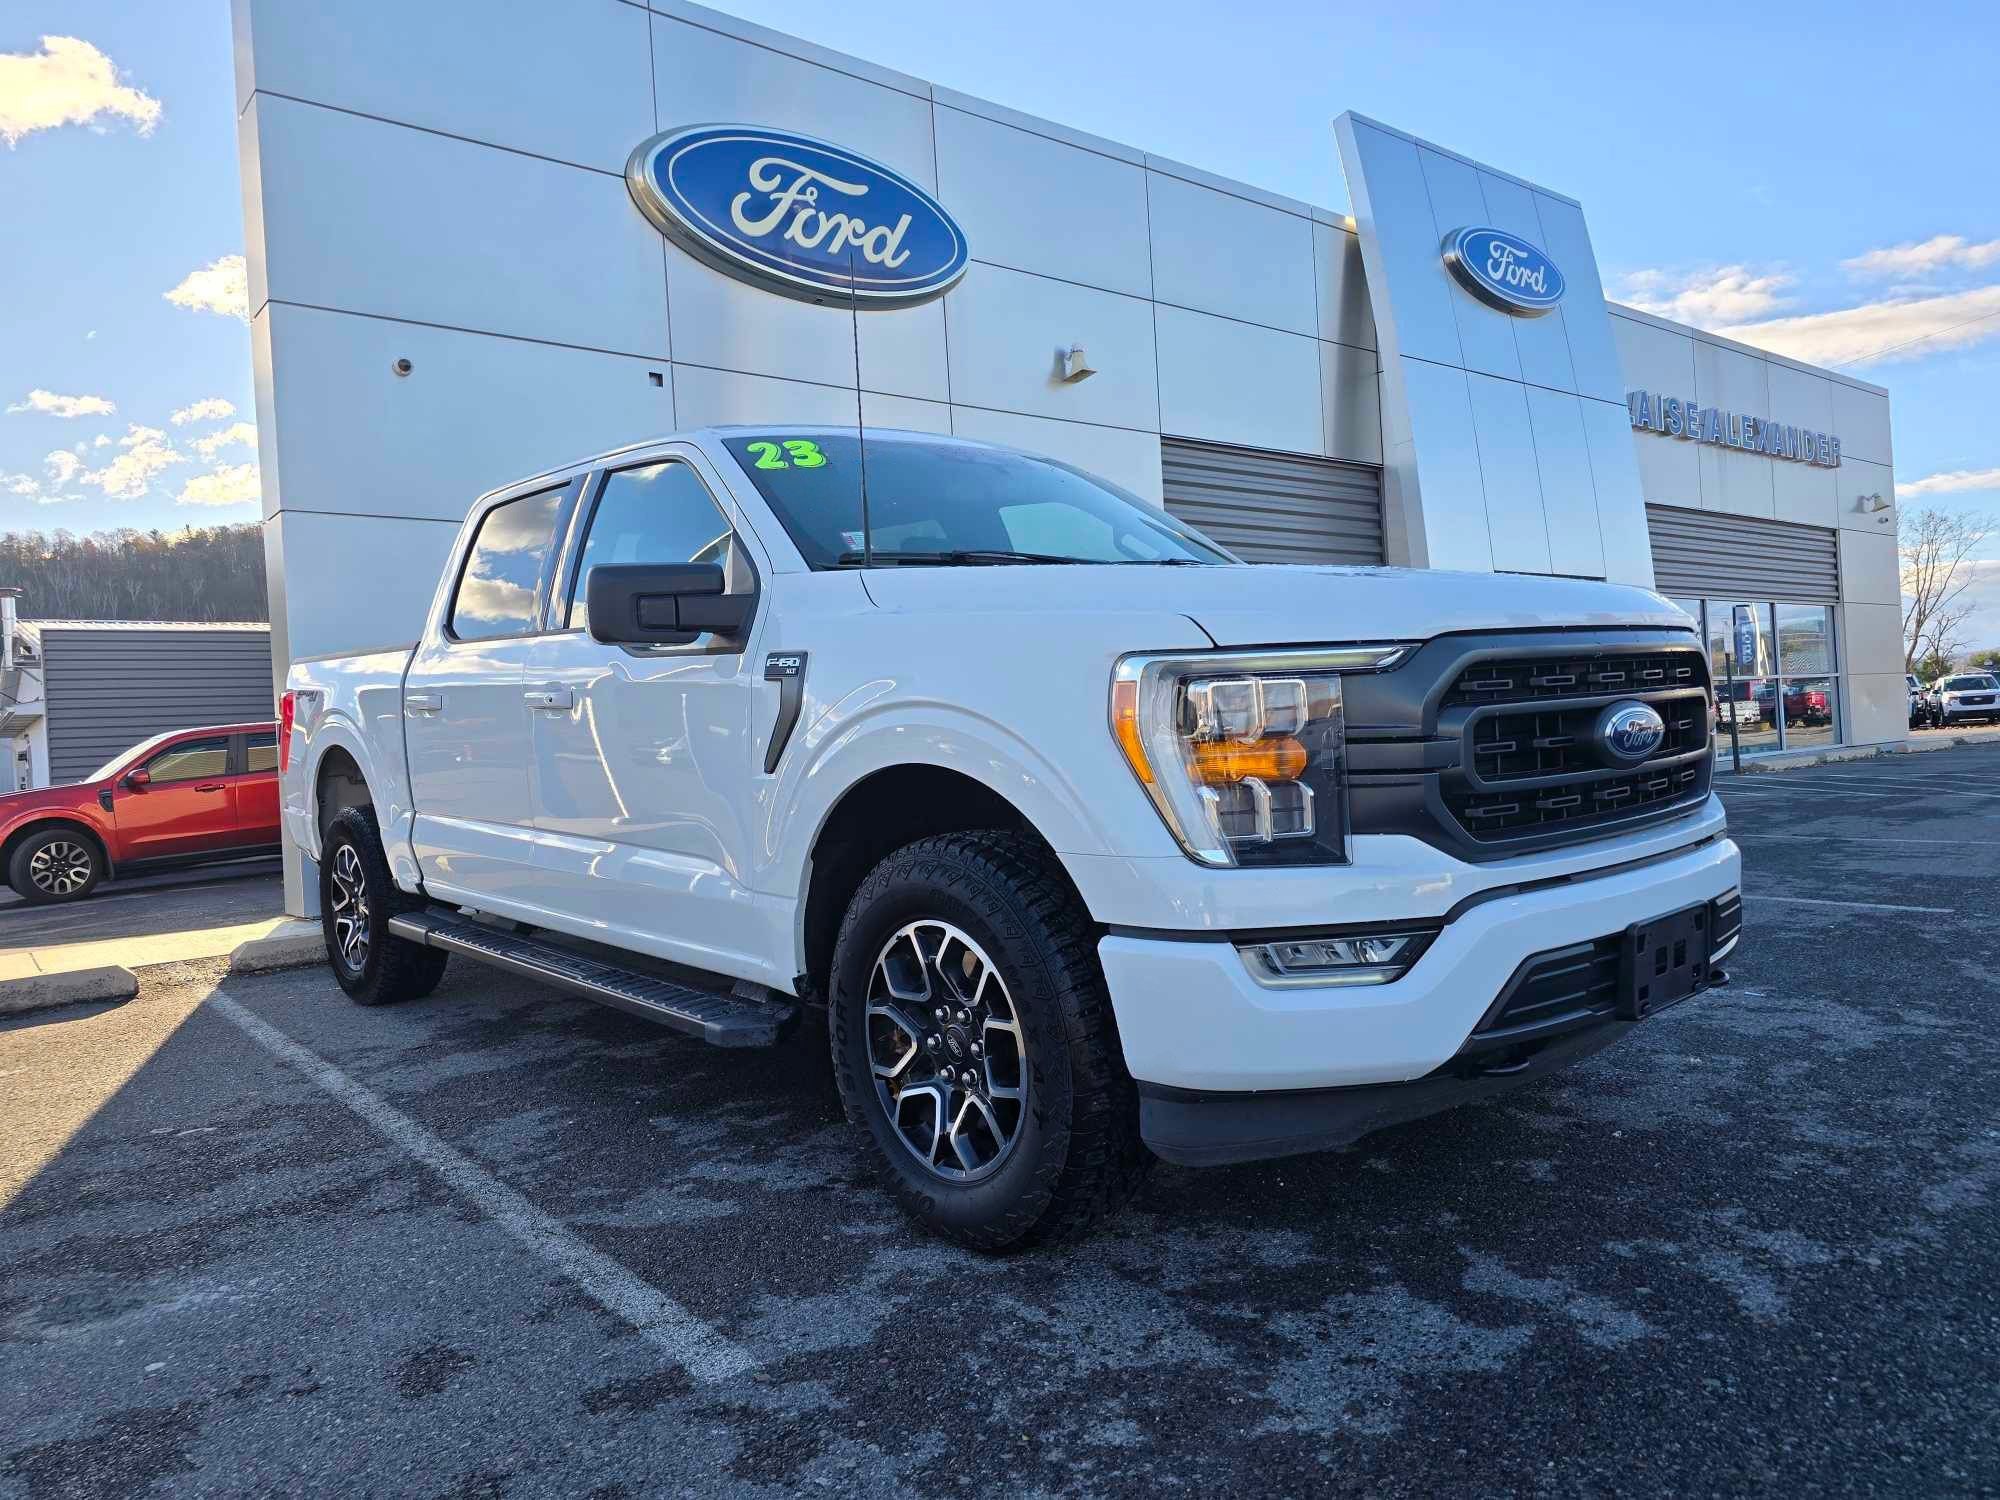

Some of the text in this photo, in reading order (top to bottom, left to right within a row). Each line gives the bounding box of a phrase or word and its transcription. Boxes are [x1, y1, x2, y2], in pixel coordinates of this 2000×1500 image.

[731, 157, 912, 268] Ford
[1487, 241, 1547, 293] Ford
[1628, 389, 1841, 467] AISE ALEXANDER
[747, 440, 826, 469] 23
[1624, 720, 1656, 748] Ford
